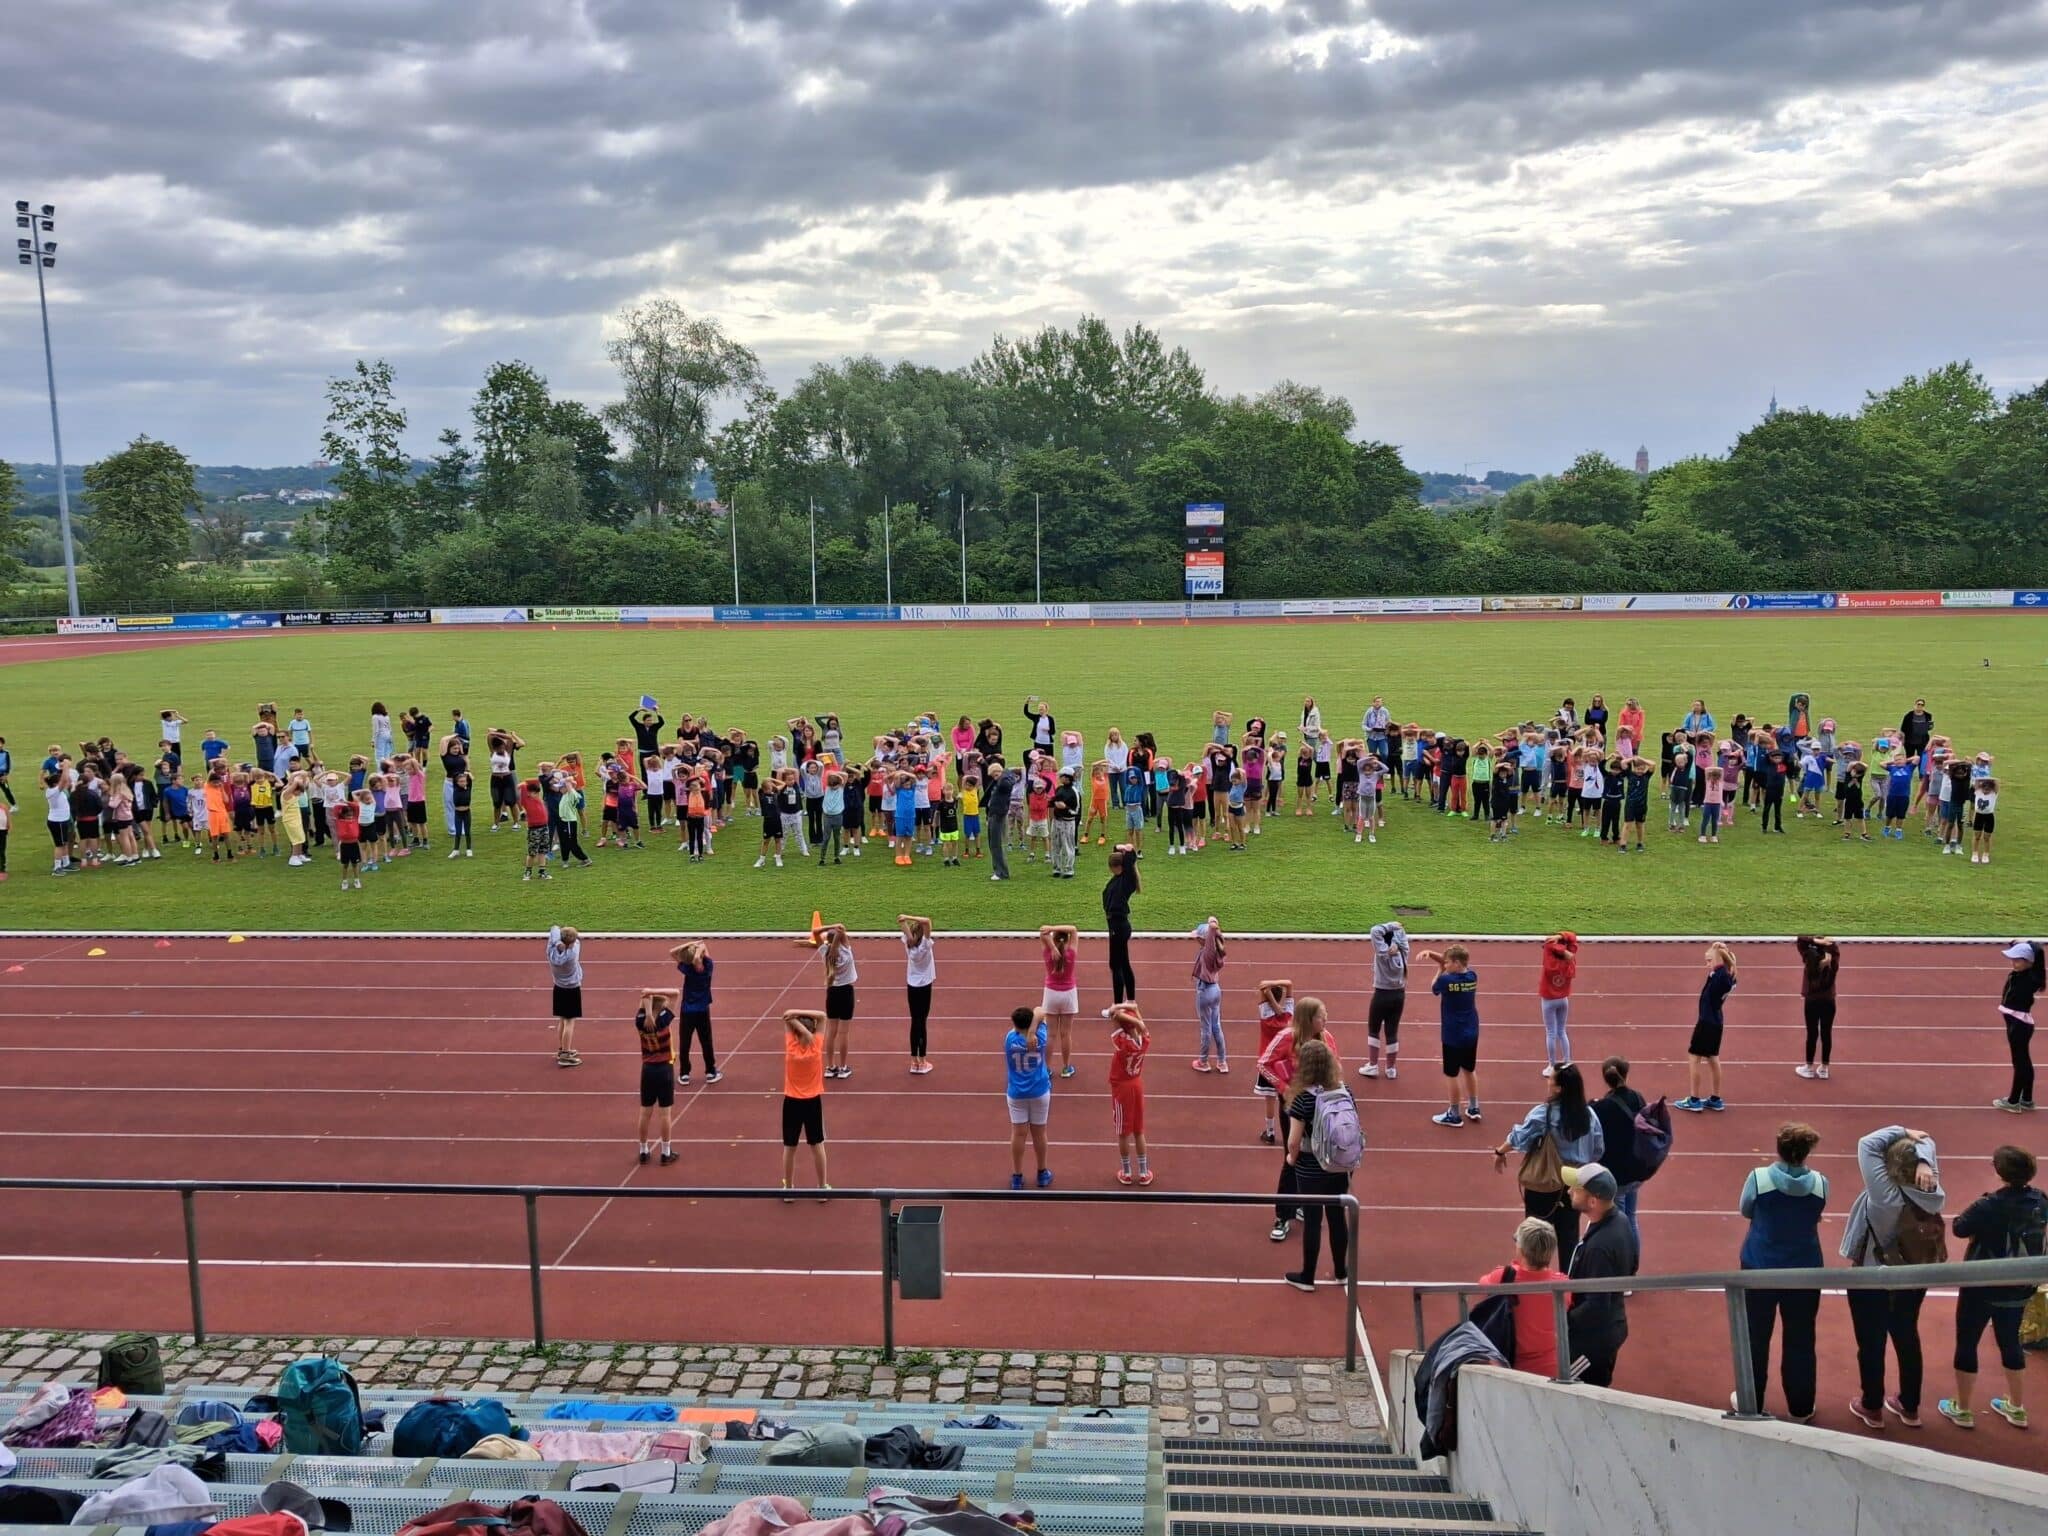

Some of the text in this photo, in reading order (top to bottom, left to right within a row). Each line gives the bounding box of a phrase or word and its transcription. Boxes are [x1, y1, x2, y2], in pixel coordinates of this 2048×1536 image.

[1194, 580, 1222, 590] KMS
[1850, 597, 1935, 608] Sparkasse Donauwörth
[545, 608, 597, 616] Staudigl-Druck
[903, 607, 924, 619] MR
[950, 606, 972, 618] MR
[997, 606, 1019, 618] MR
[1044, 605, 1065, 617] MR
[1448, 983, 1460, 992] SG
[1010, 1051, 1043, 1075] 10
